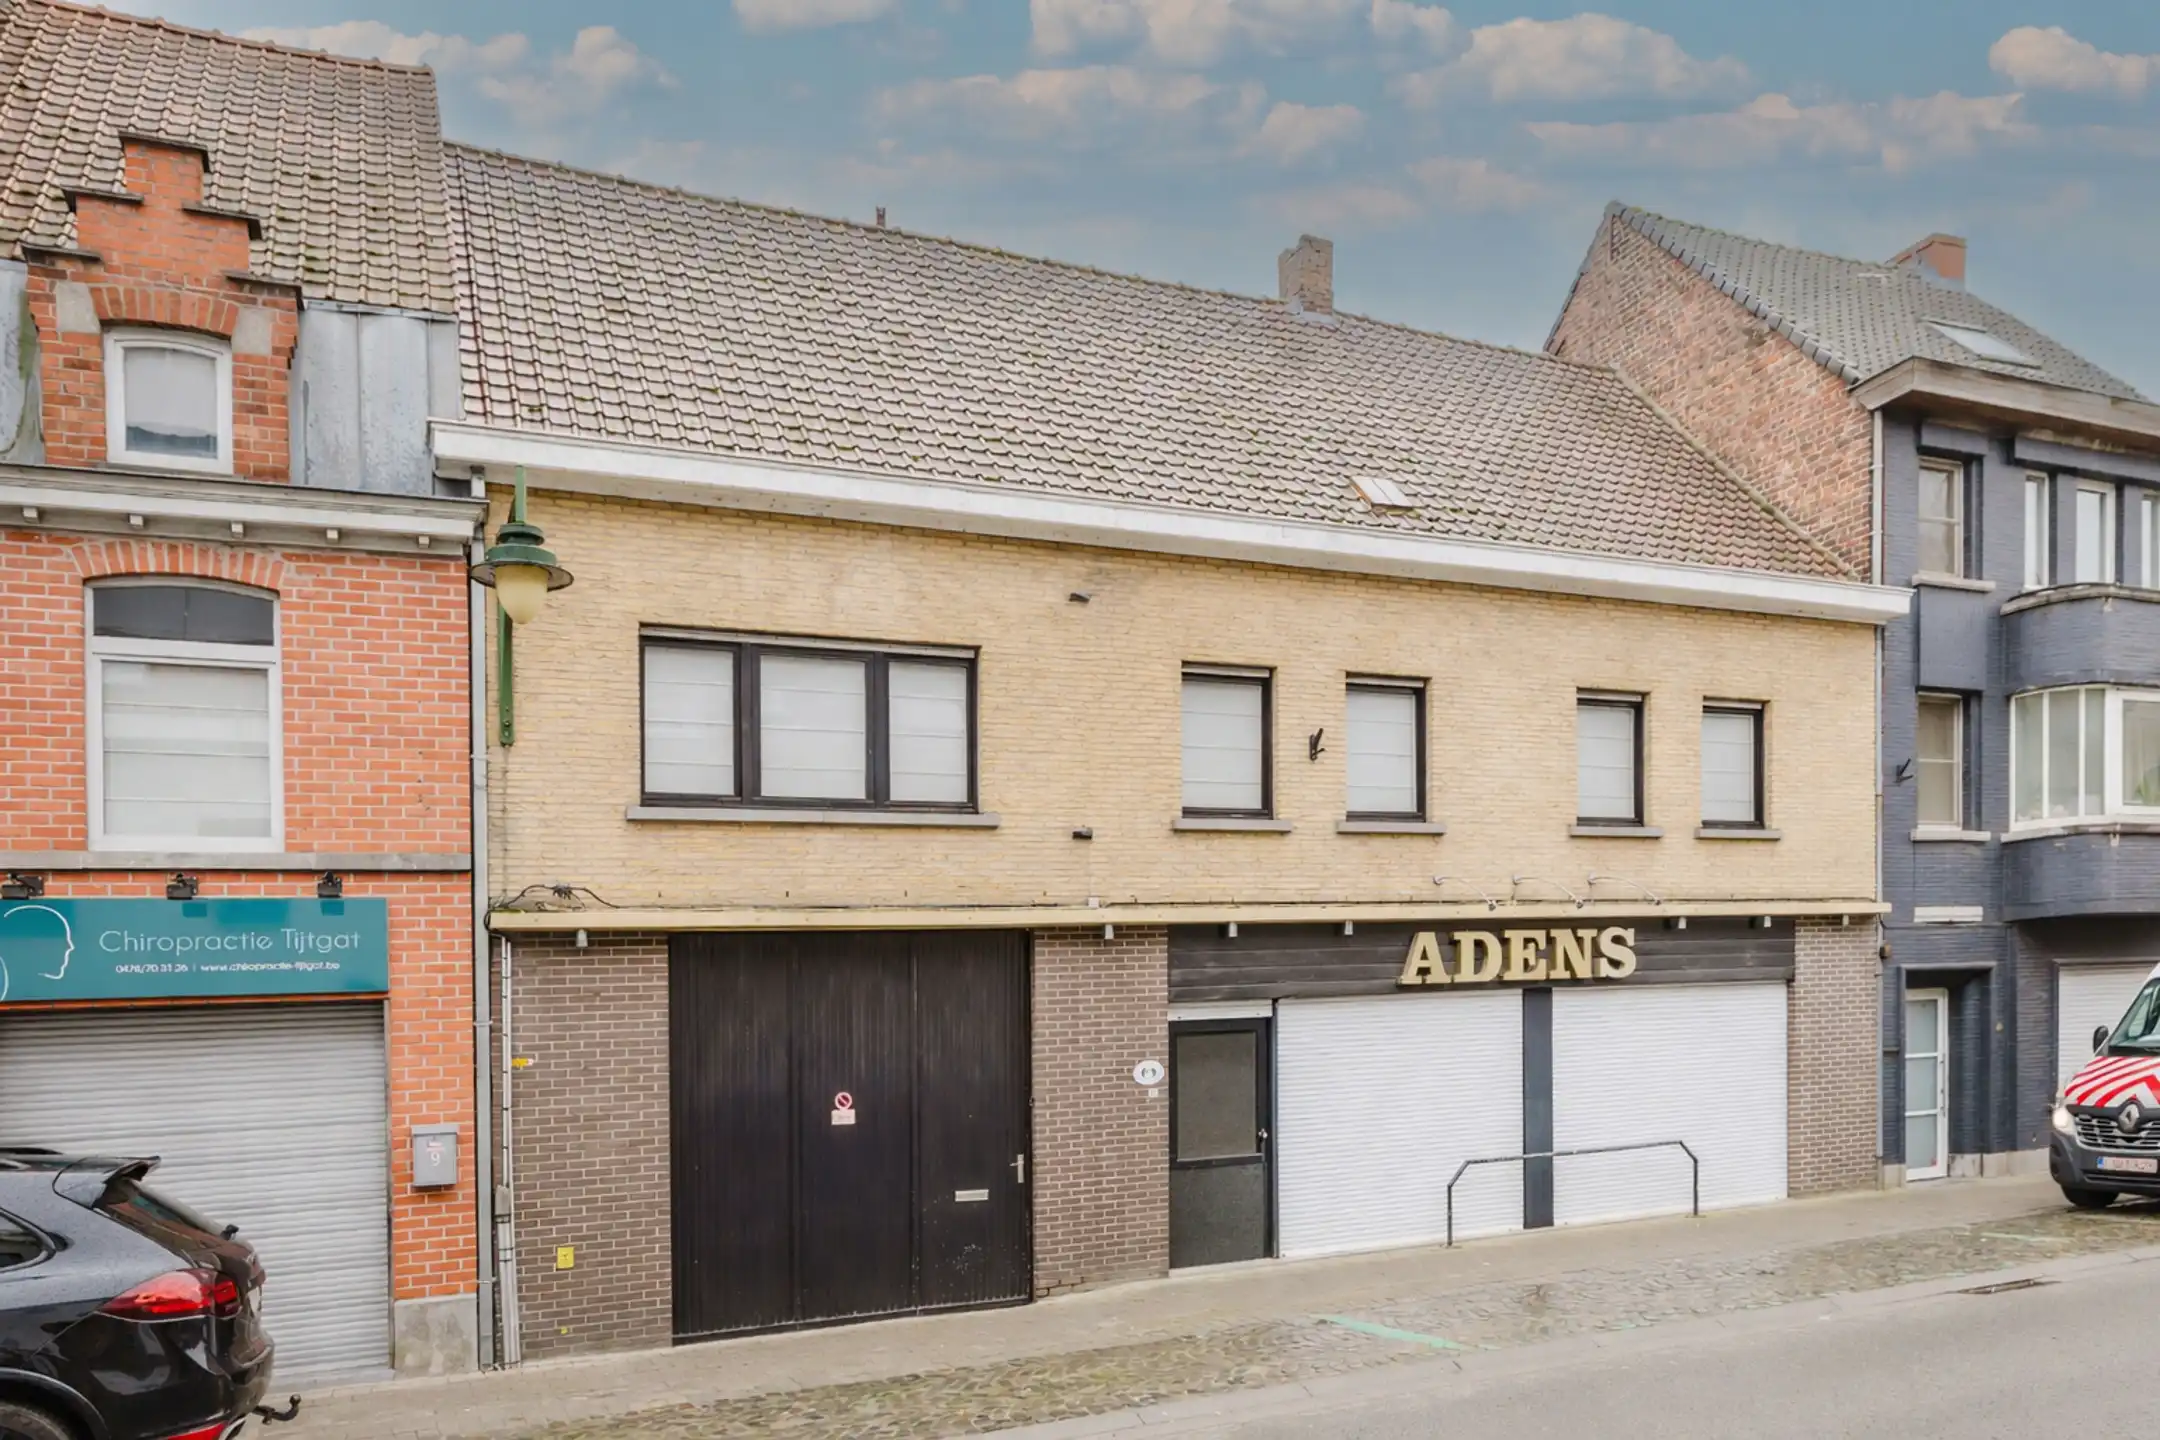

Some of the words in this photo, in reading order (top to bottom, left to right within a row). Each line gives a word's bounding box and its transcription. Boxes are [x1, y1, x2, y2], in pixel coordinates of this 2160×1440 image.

[99, 929, 273, 956] Chiropractie
[281, 928, 361, 954] Tijtgat
[1399, 926, 1637, 985] ADENS
[430, 1151, 441, 1167] 9
